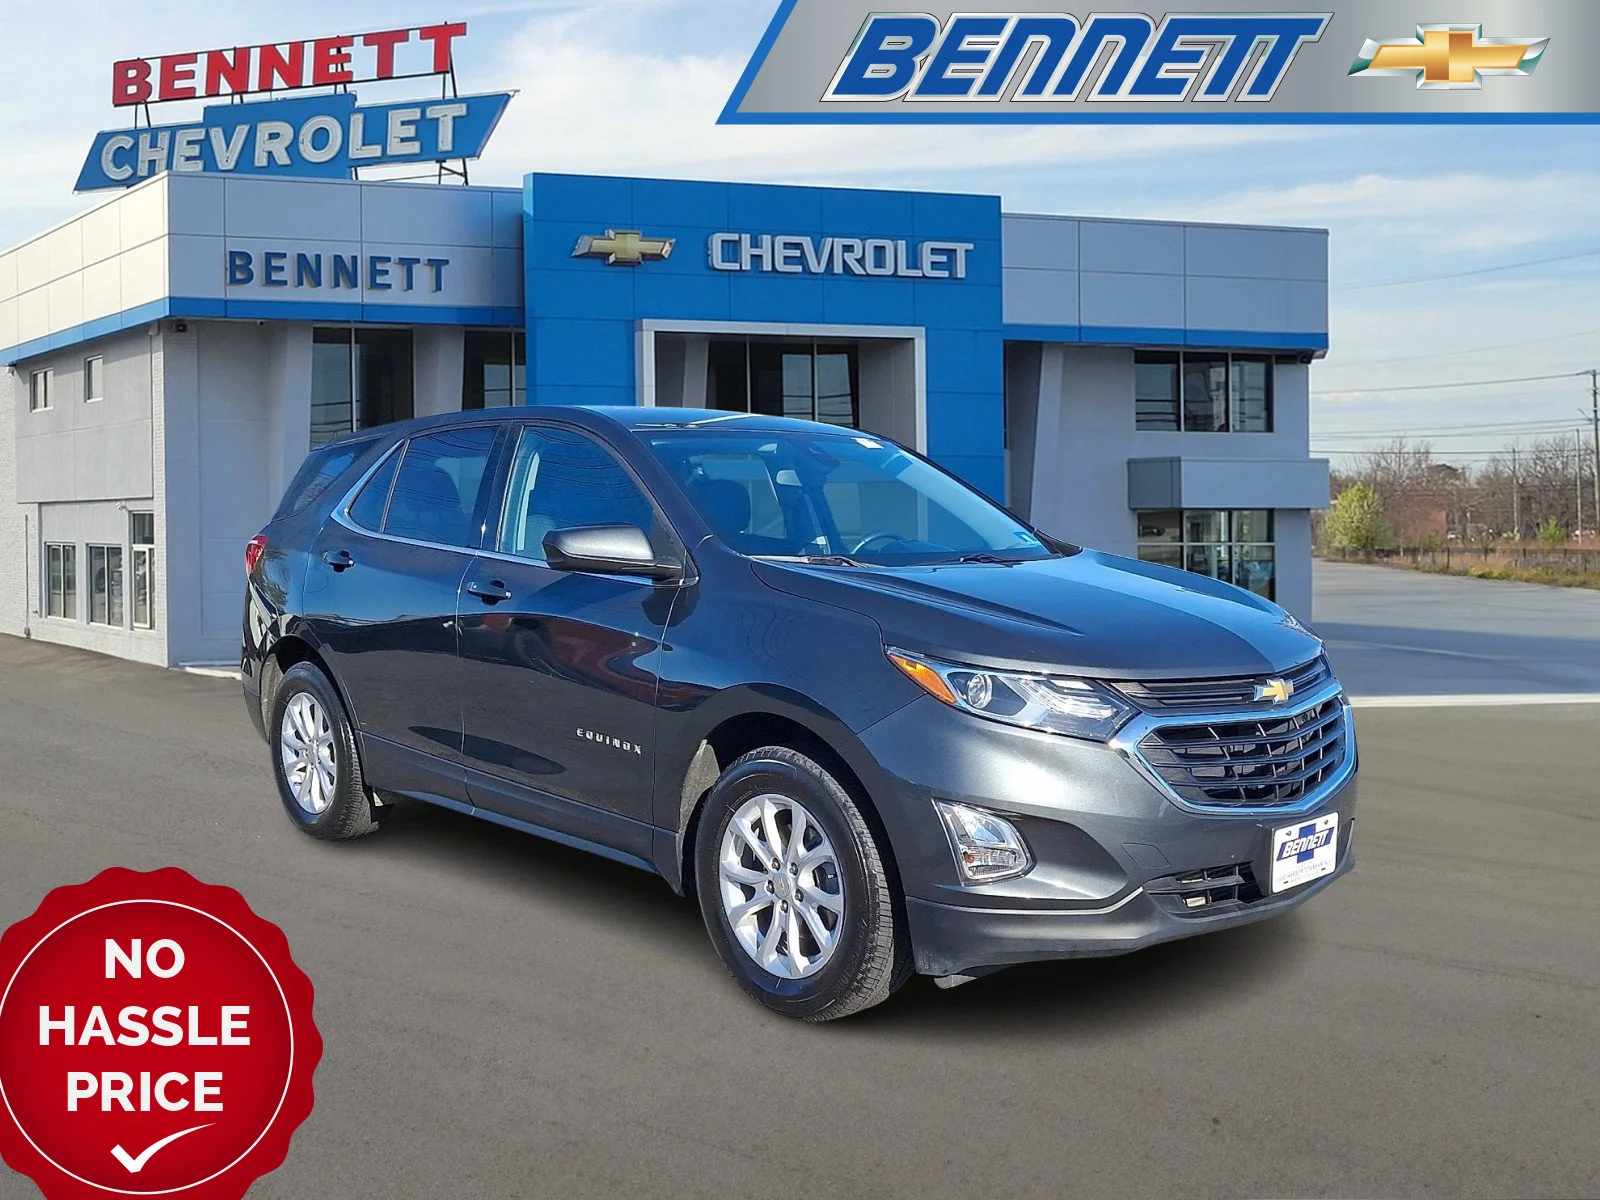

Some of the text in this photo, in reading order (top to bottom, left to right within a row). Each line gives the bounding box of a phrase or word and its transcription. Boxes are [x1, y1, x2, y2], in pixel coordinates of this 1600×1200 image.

[112, 22, 467, 106] BENNETT
[100, 103, 468, 181] CHEVROLET
[227, 250, 450, 292] BENNETT
[708, 232, 974, 279] CHEVROLET
[576, 727, 642, 755] EQUINOX
[1281, 829, 1329, 858] BENNETT
